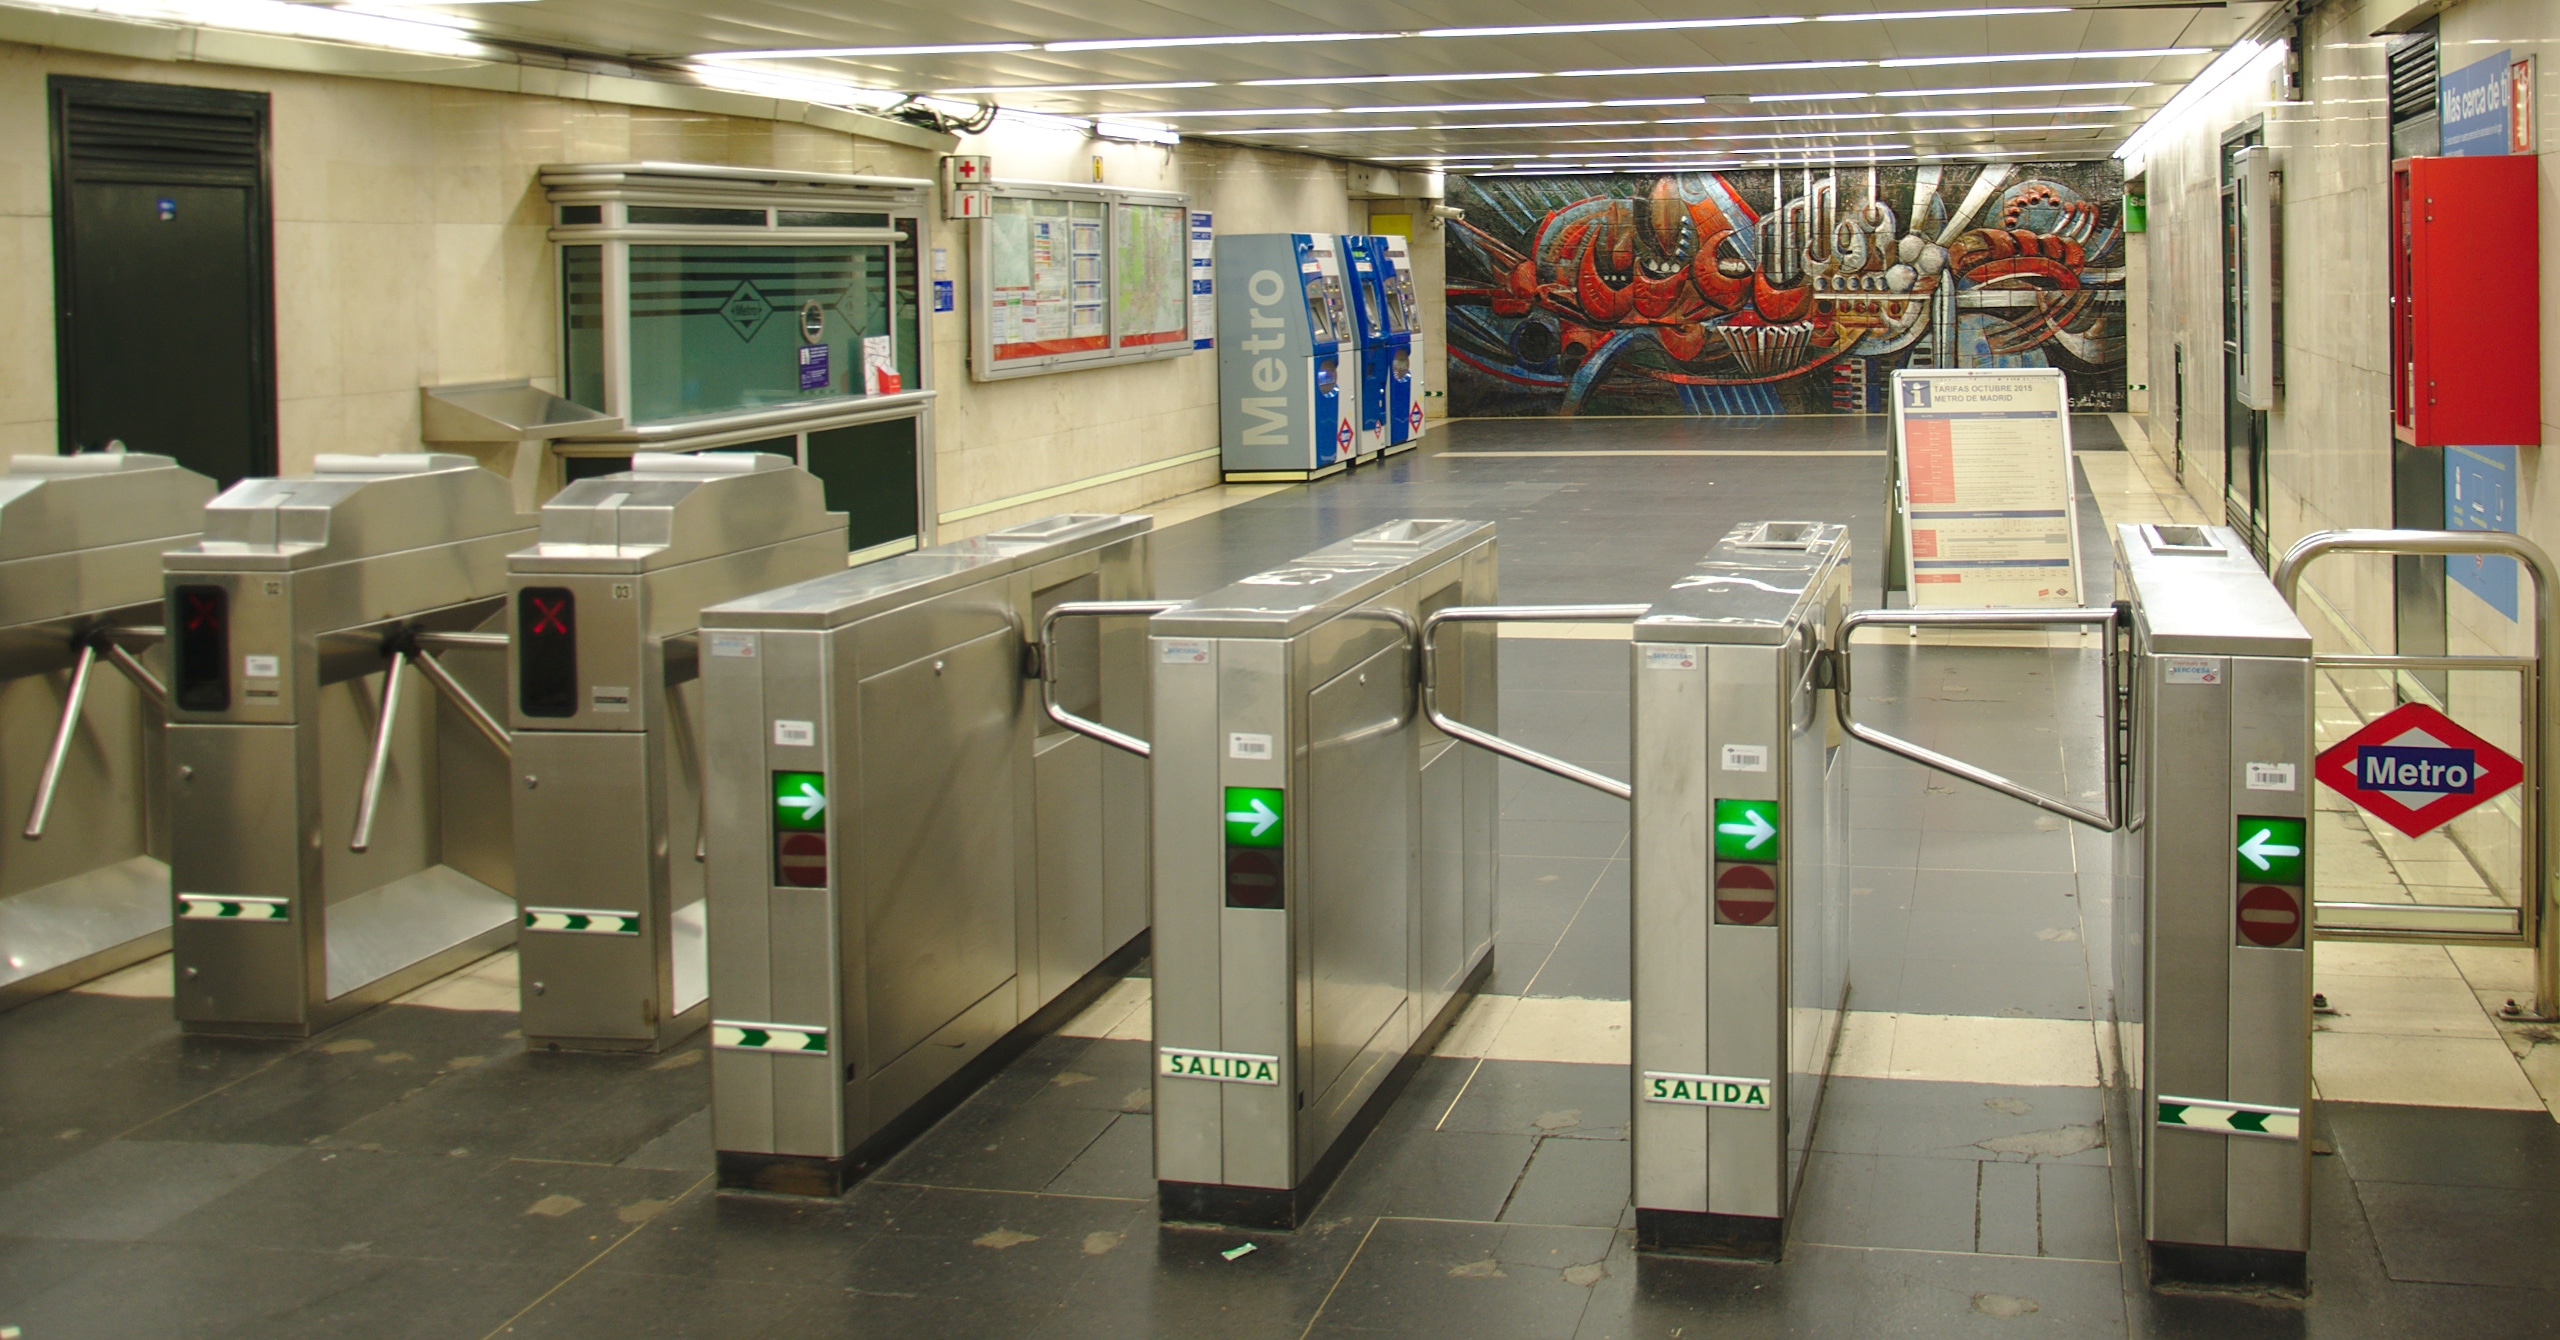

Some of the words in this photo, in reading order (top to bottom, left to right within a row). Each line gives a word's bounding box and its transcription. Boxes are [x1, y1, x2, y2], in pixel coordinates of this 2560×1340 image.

[2443, 87, 2461, 125] Más
[2462, 86, 2486, 120] cerca
[2487, 73, 2500, 112] de
[1241, 269, 1289, 446] Metro
[1934, 385, 1970, 393] TARIFAS
[1972, 384, 2012, 393] OCTUBRE
[2014, 384, 2033, 392] 2015
[1966, 394, 1977, 402] DE
[1980, 394, 2013, 402] MADRID
[2366, 756, 2468, 788] Metro
[1171, 1055, 1273, 1080] SALIDA
[1653, 1079, 1765, 1104] SALIDA
